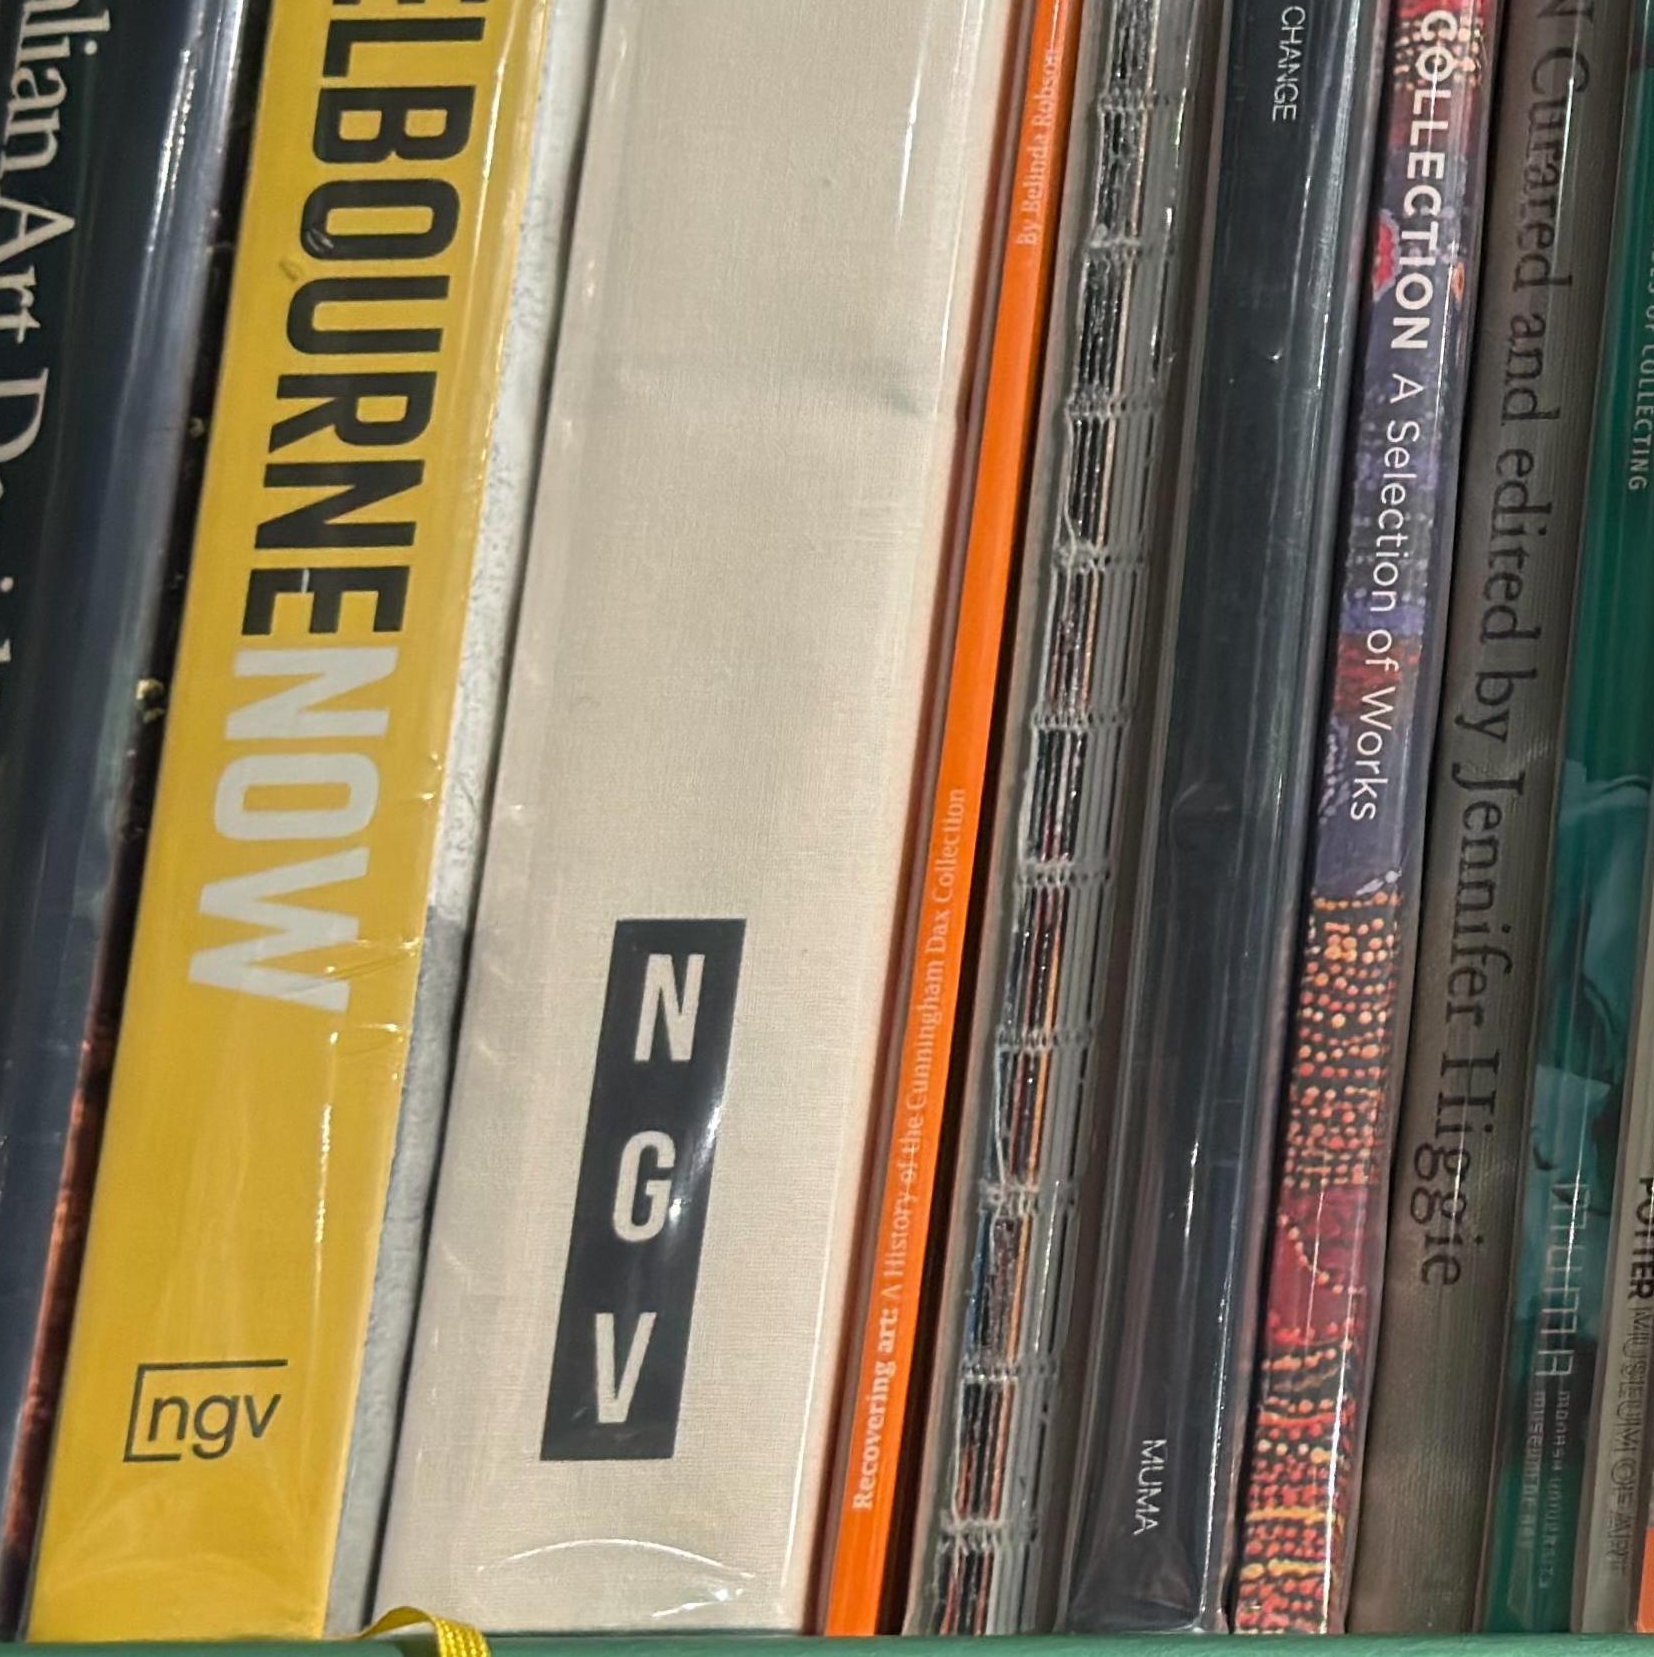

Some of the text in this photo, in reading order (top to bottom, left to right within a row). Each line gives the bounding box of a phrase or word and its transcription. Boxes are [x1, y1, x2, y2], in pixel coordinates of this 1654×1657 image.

[1271, 6, 1306, 122] CHANGE
[1392, 11, 1459, 349] COLLECTION
[1387, 373, 1426, 403] A
[1368, 421, 1422, 611] Selection
[1363, 630, 1403, 670] of
[1349, 686, 1398, 820] Works
[1131, 1440, 1167, 1537] MUMA
